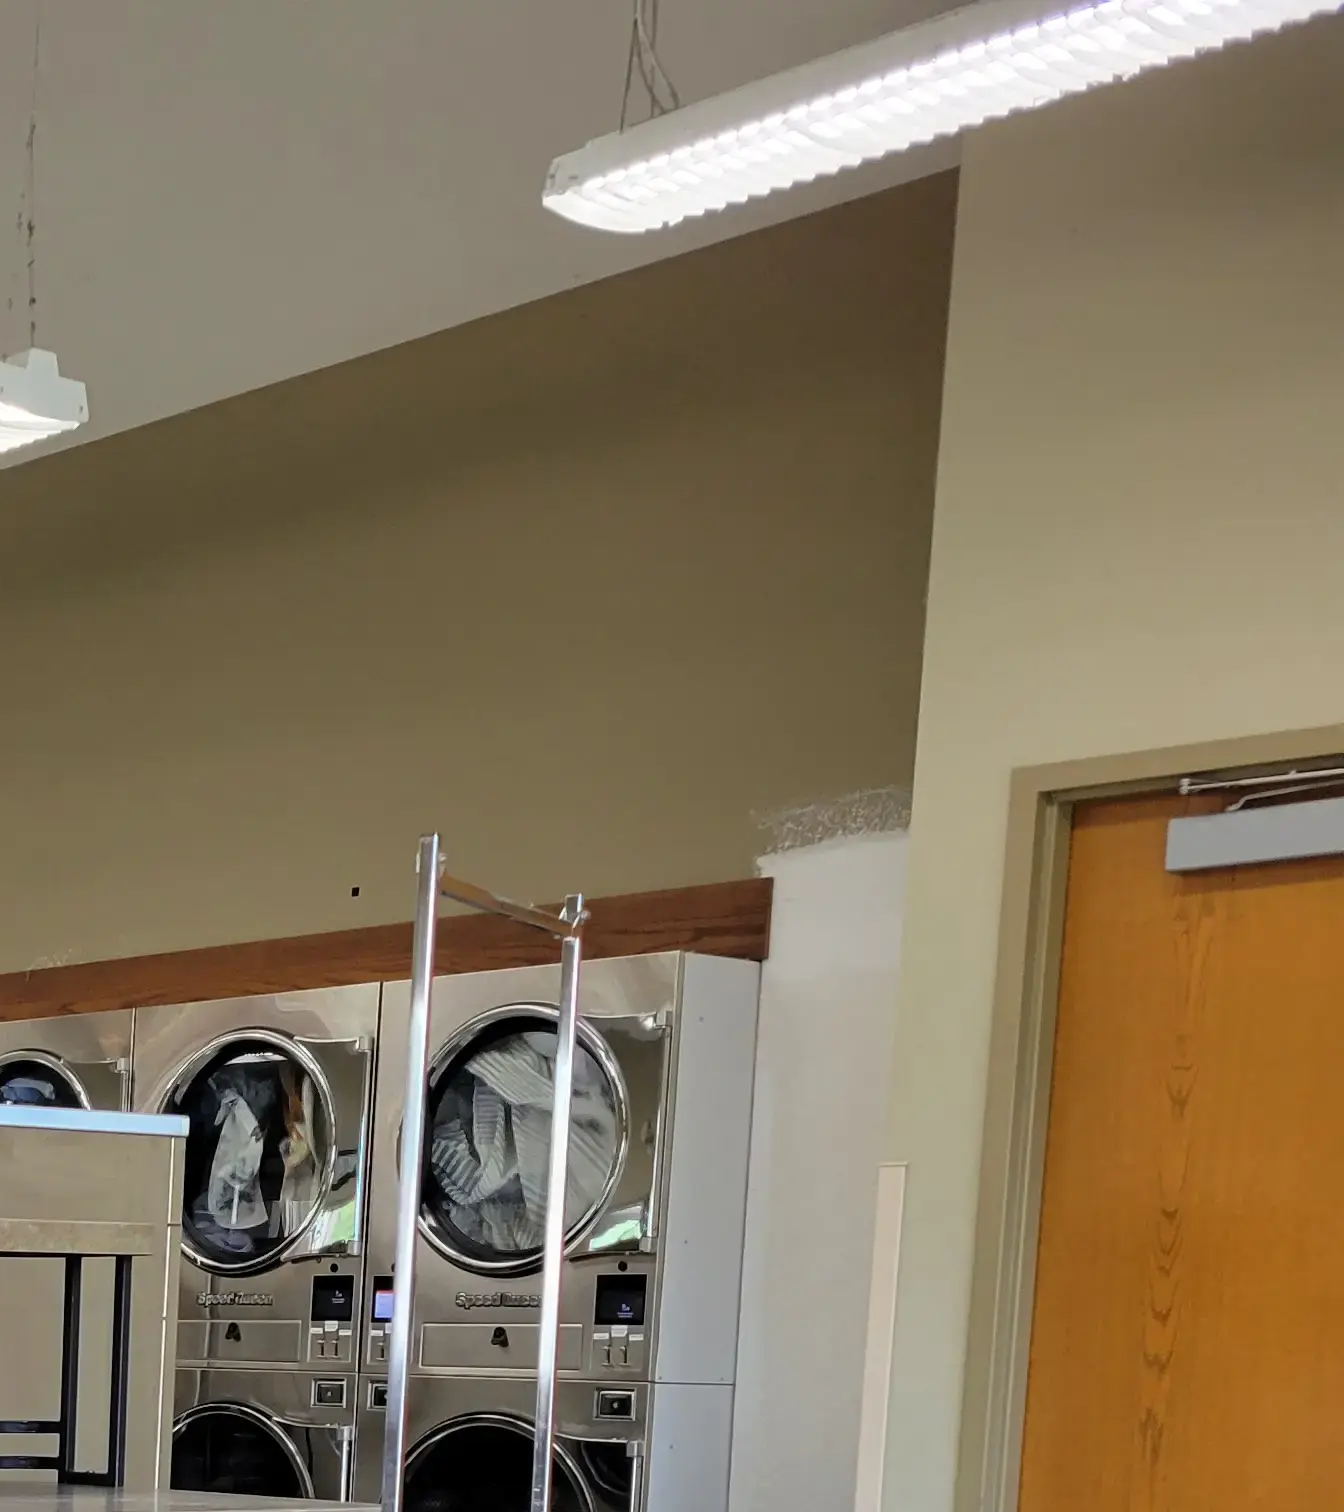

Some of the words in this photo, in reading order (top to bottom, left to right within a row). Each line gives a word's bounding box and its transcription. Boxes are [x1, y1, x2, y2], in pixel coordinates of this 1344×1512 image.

[196, 1290, 234, 1308] Speed
[455, 1291, 502, 1310] Speed
[502, 1291, 542, 1308] Quee
